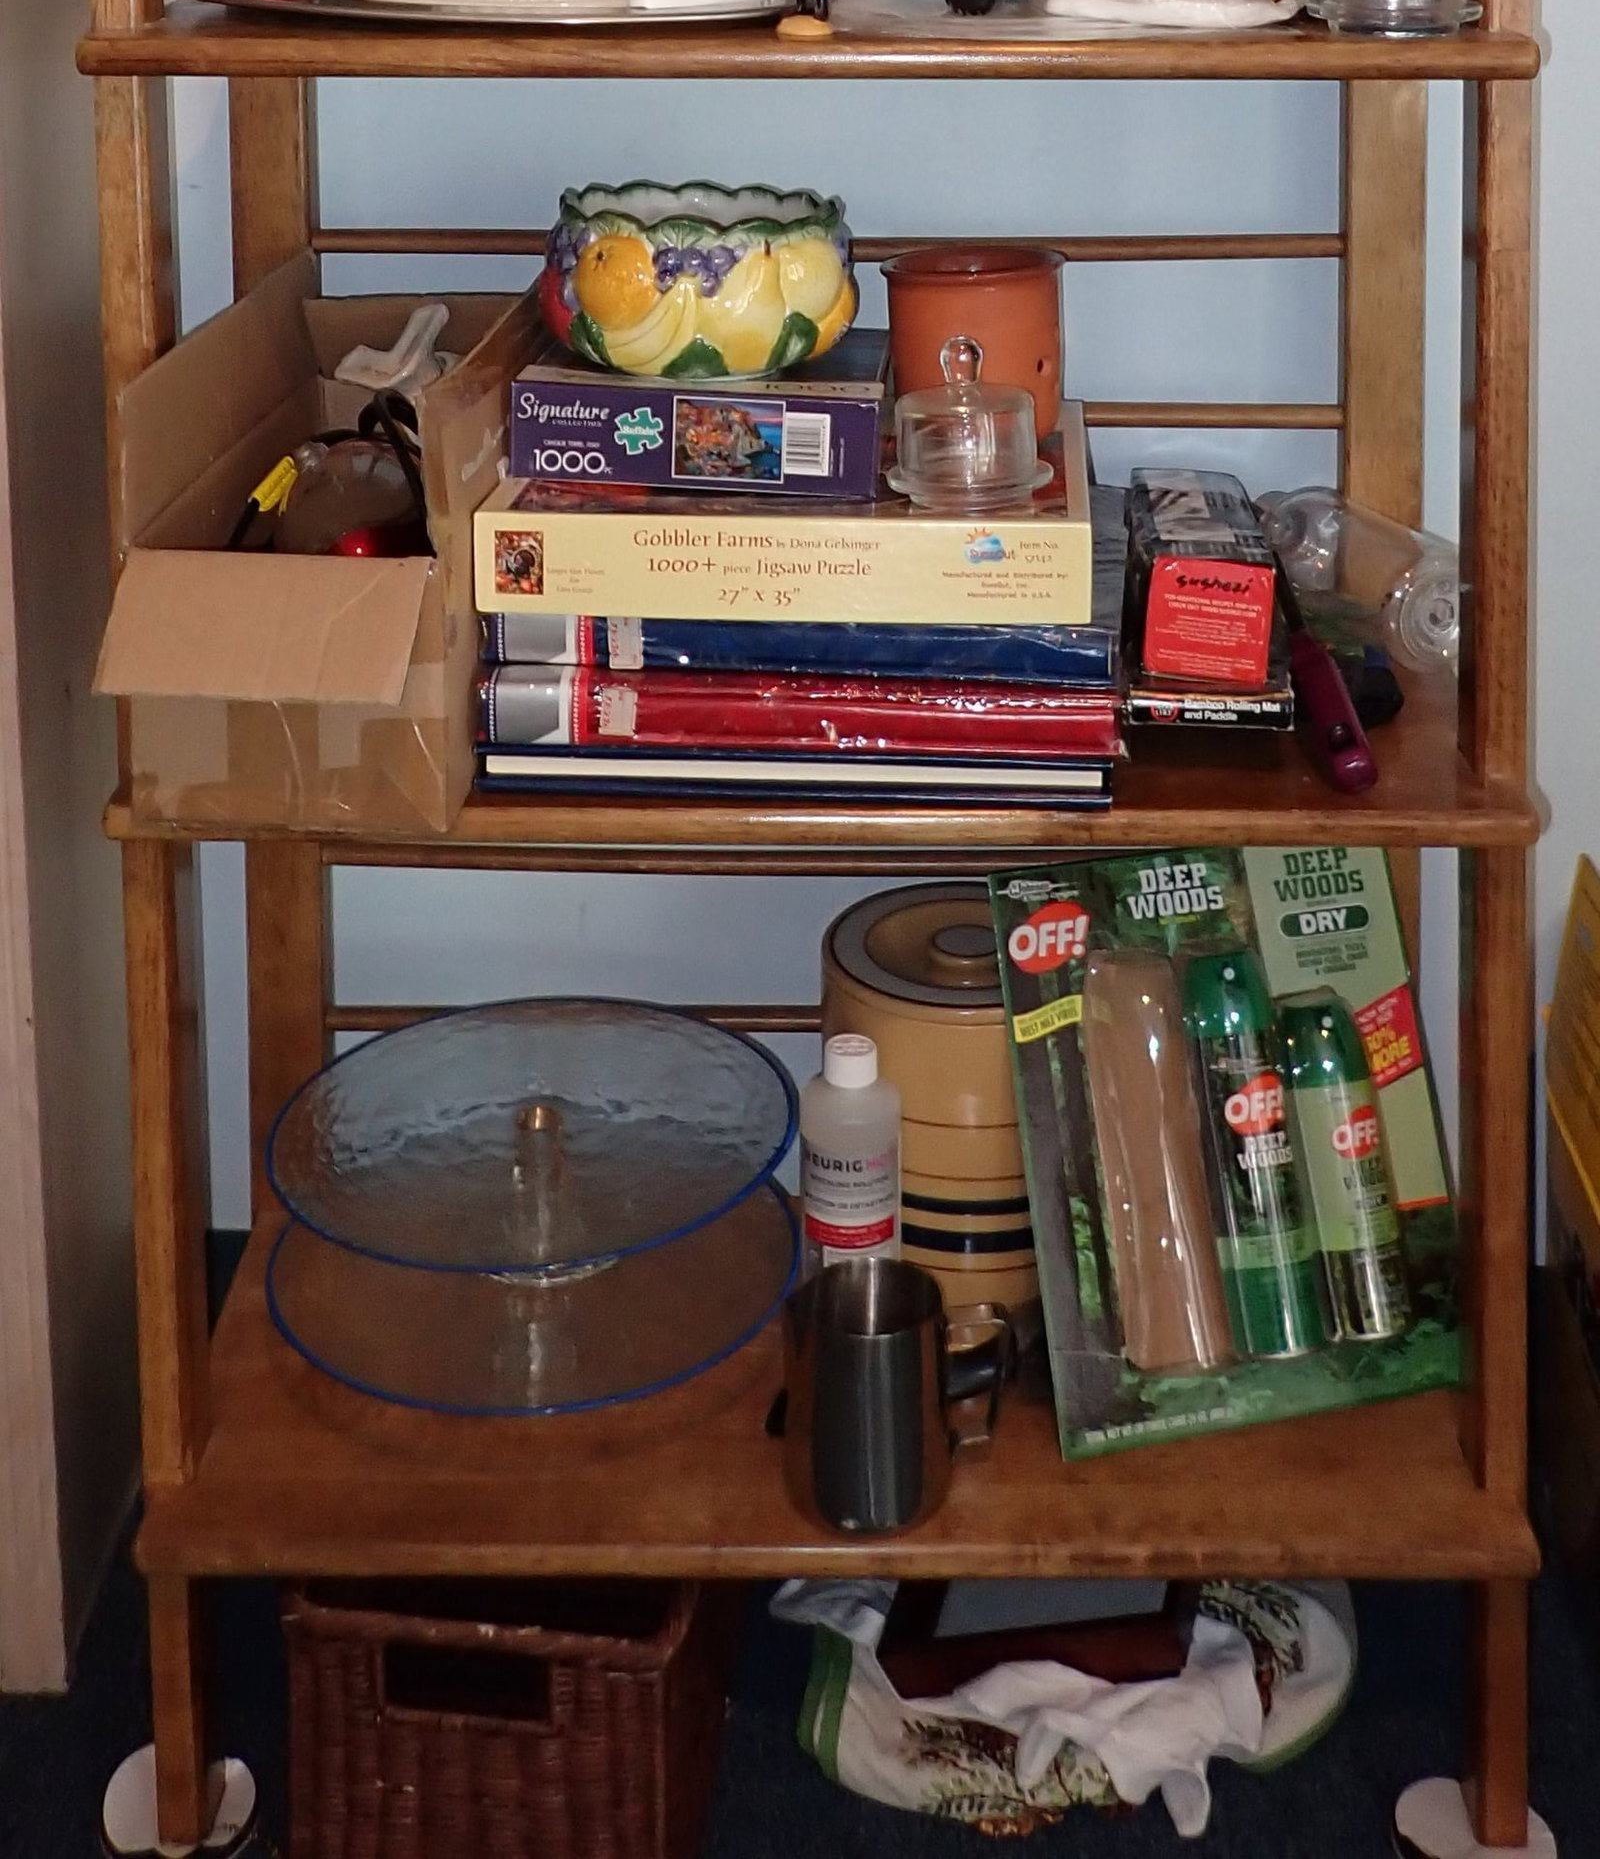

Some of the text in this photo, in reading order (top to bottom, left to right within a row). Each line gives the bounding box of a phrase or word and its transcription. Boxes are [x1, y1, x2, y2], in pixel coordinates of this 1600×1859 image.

[517, 392, 611, 423] Signature
[533, 448, 606, 475] 1000
[633, 528, 711, 548] Gobbler
[716, 530, 773, 548] Farms
[790, 539, 822, 549] Dona
[1020, 541, 1041, 550] Item
[648, 556, 872, 579] 1000+ piece Jigsaw Puzzle
[1184, 698, 1225, 710] Bamboo
[1227, 700, 1261, 714] Rolling
[1262, 702, 1281, 713] Mat
[1184, 710, 1238, 721] and Paddle
[1283, 847, 1348, 875] DEEP
[1138, 863, 1207, 893] DEEP
[1273, 869, 1364, 902] WOODS
[1127, 886, 1224, 920] WOODS
[1298, 908, 1348, 935] DRY
[1008, 914, 1090, 961] OFF!
[1237, 1145, 1293, 1170] WOODS
